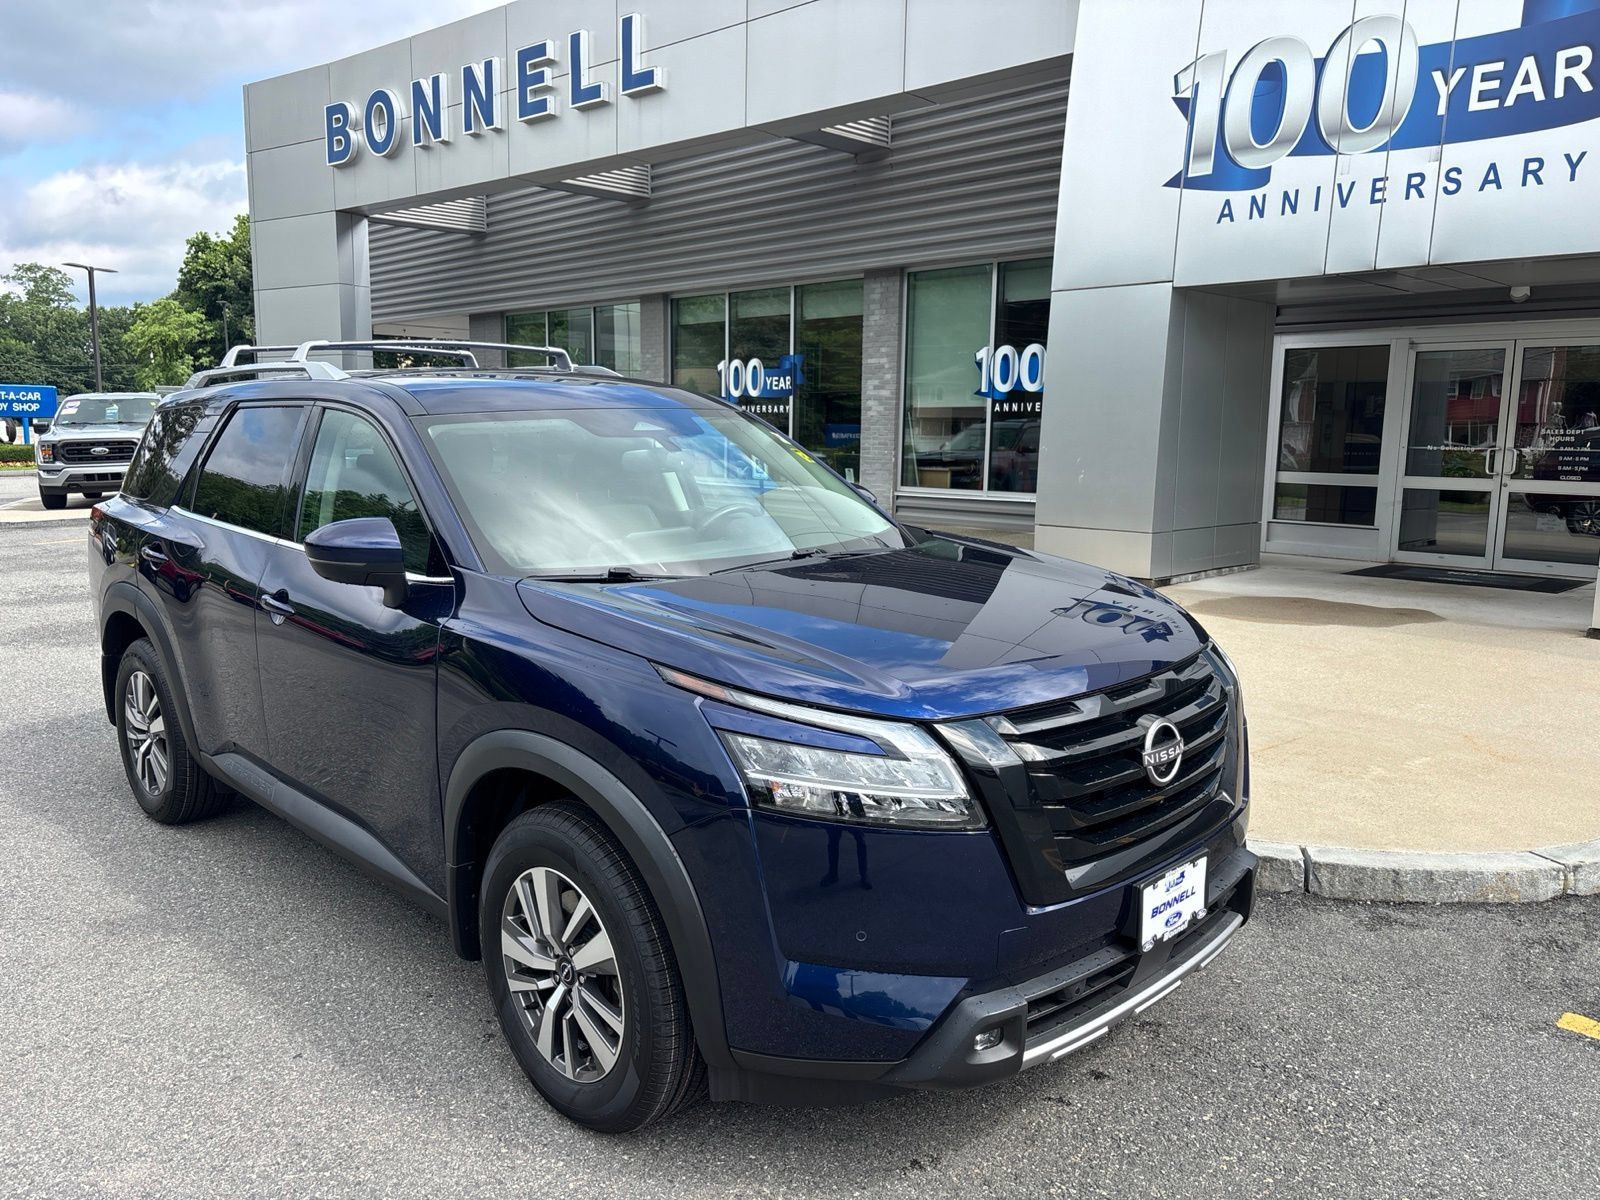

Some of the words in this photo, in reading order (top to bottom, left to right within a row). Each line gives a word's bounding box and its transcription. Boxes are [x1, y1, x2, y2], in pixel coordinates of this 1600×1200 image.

[324, 12, 664, 168] BONNELL
[1173, 13, 1420, 178] 100
[1430, 44, 1594, 117] YEAR
[1216, 151, 1588, 224] ANNIVERSARY
[717, 358, 764, 398] 100
[766, 376, 792, 390] YEAR
[975, 343, 1047, 393] 100
[12, 402, 40, 412] SHOP
[994, 402, 1041, 412] ANNIVE
[1144, 742, 1185, 765] NISSAN
[1151, 885, 1196, 919] BONNELL
